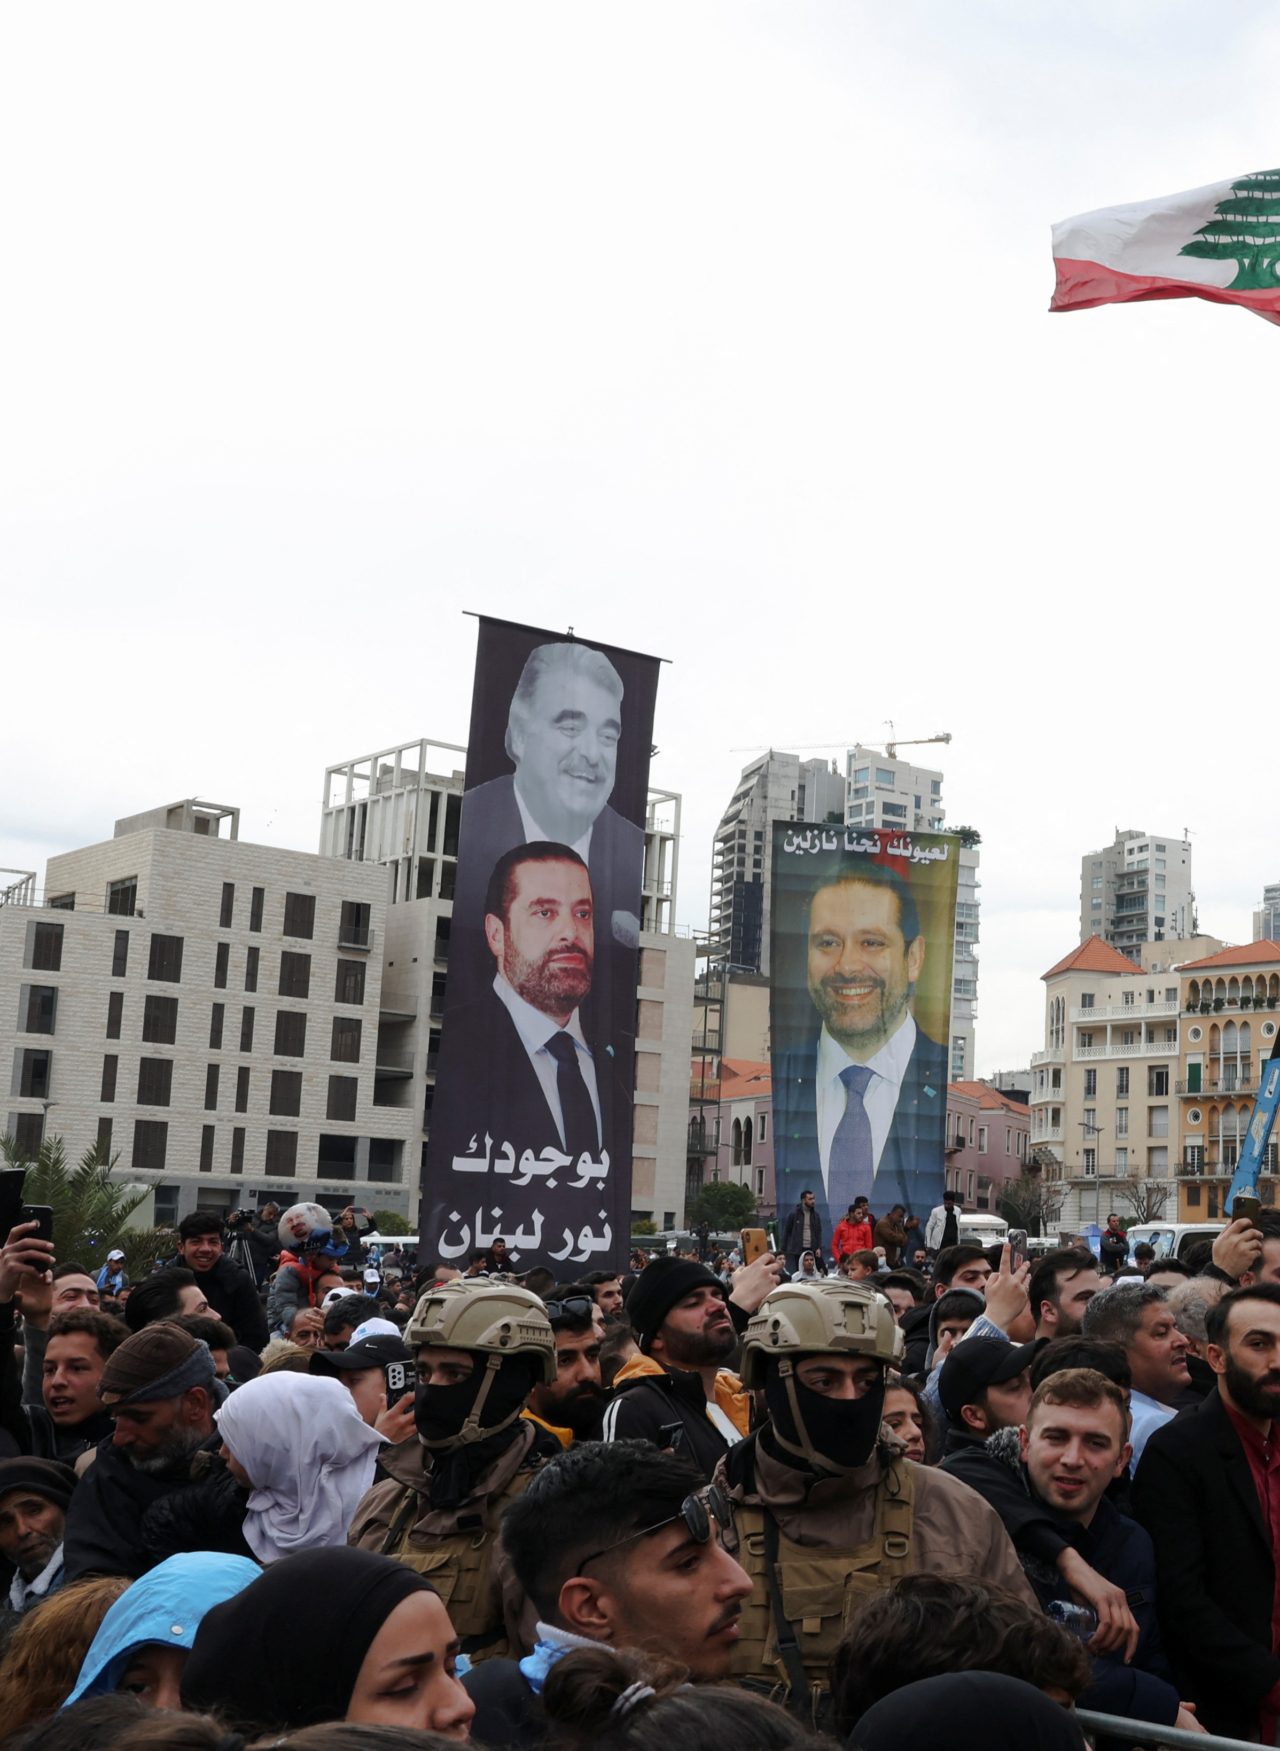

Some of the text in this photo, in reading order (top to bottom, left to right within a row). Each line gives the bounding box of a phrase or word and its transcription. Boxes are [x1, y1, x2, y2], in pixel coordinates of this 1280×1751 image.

[783, 829, 949, 864] لعيونك نحنا نازلين
[452, 1130, 610, 1191] بوجودك
[438, 1206, 613, 1263] نور لبنان
